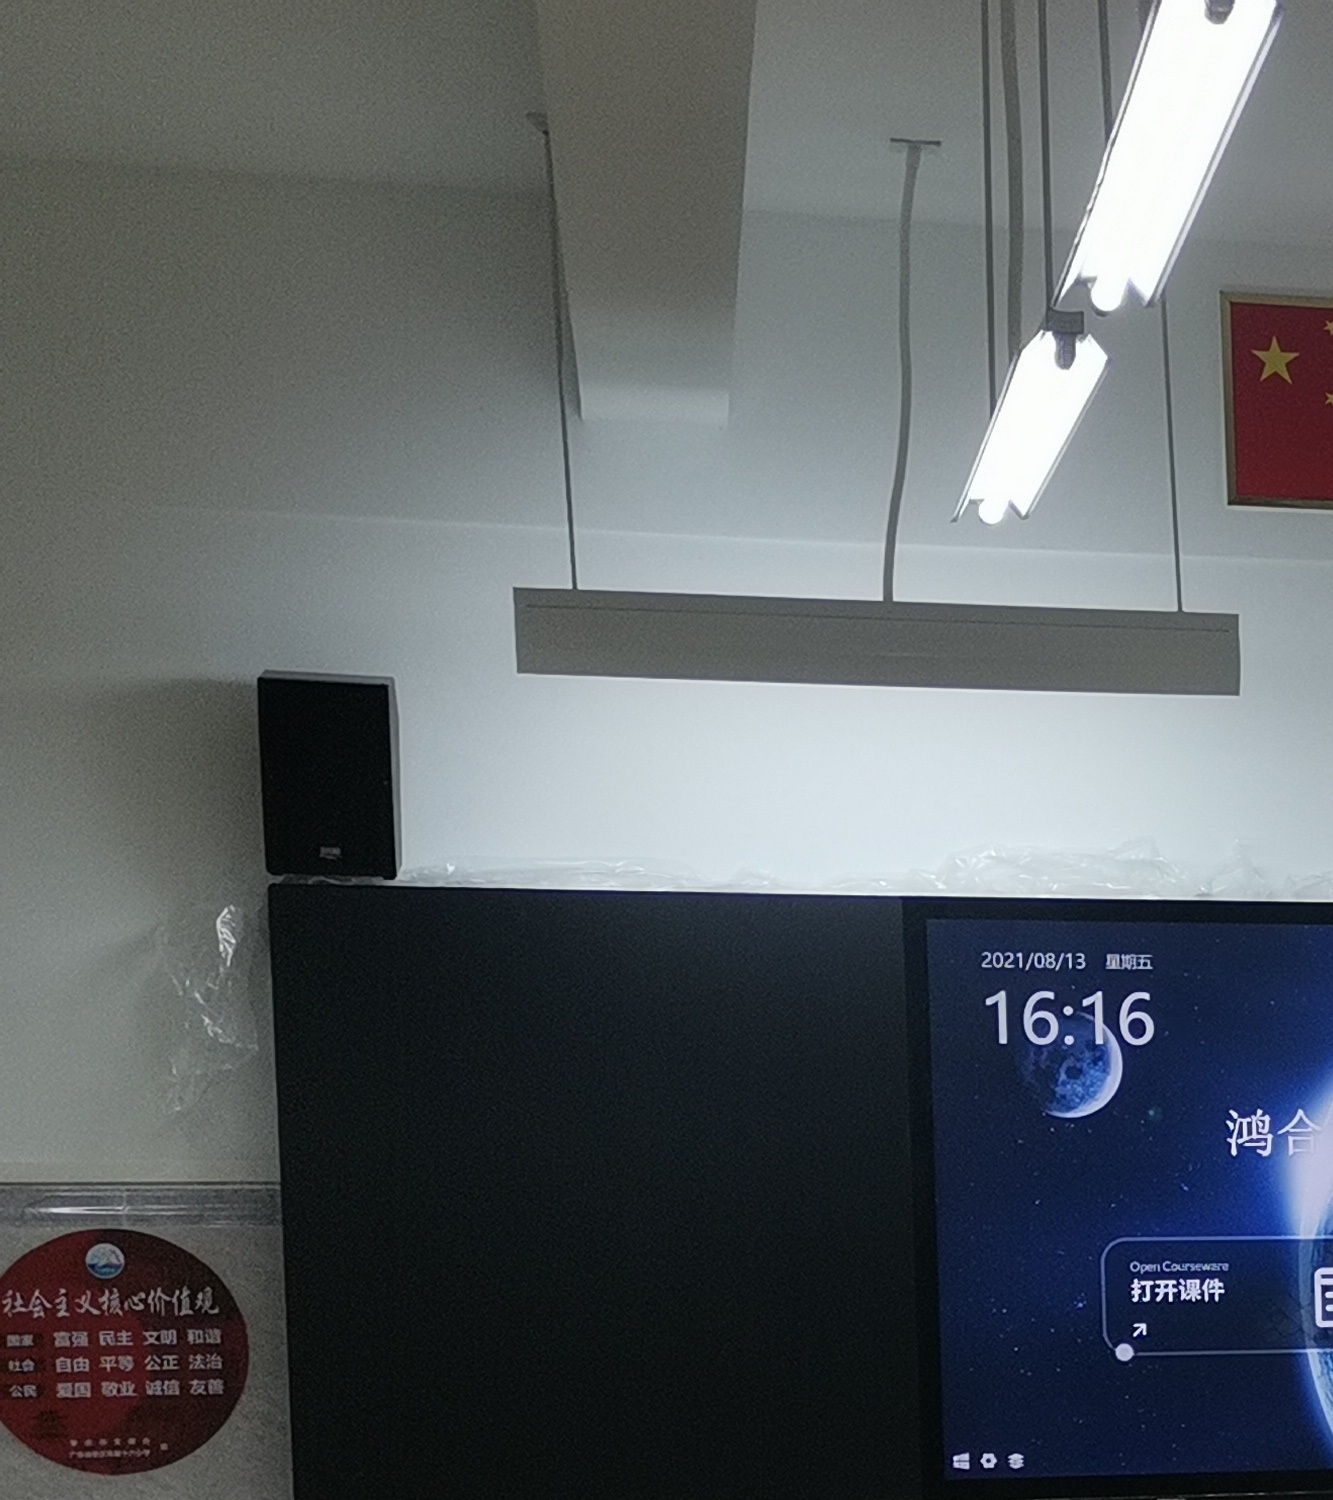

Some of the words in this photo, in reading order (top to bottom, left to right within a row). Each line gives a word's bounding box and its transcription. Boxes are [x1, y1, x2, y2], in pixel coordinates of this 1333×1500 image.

[981, 952, 1087, 971] 2021/08/13
[1105, 953, 1154, 970] 星期五
[985, 990, 1155, 1046] 16:16
[1129, 1261, 1160, 1274] Open
[1162, 1261, 1230, 1273] Courseware
[1130, 1278, 1225, 1302] 打开课件
[2, 1286, 220, 1318] 社会主义核心价值观
[54, 1331, 90, 1347] 富强
[99, 1330, 133, 1346] 民主
[143, 1329, 178, 1345] 文明
[187, 1328, 222, 1344] 和谐
[55, 1356, 90, 1373] 自由
[99, 1355, 134, 1372] 平等
[144, 1354, 180, 1371] 公正
[189, 1354, 223, 1370] 法治
[101, 1382, 137, 1397] 敬业
[146, 1380, 180, 1396] 诚信
[189, 1379, 224, 1395] 友善
